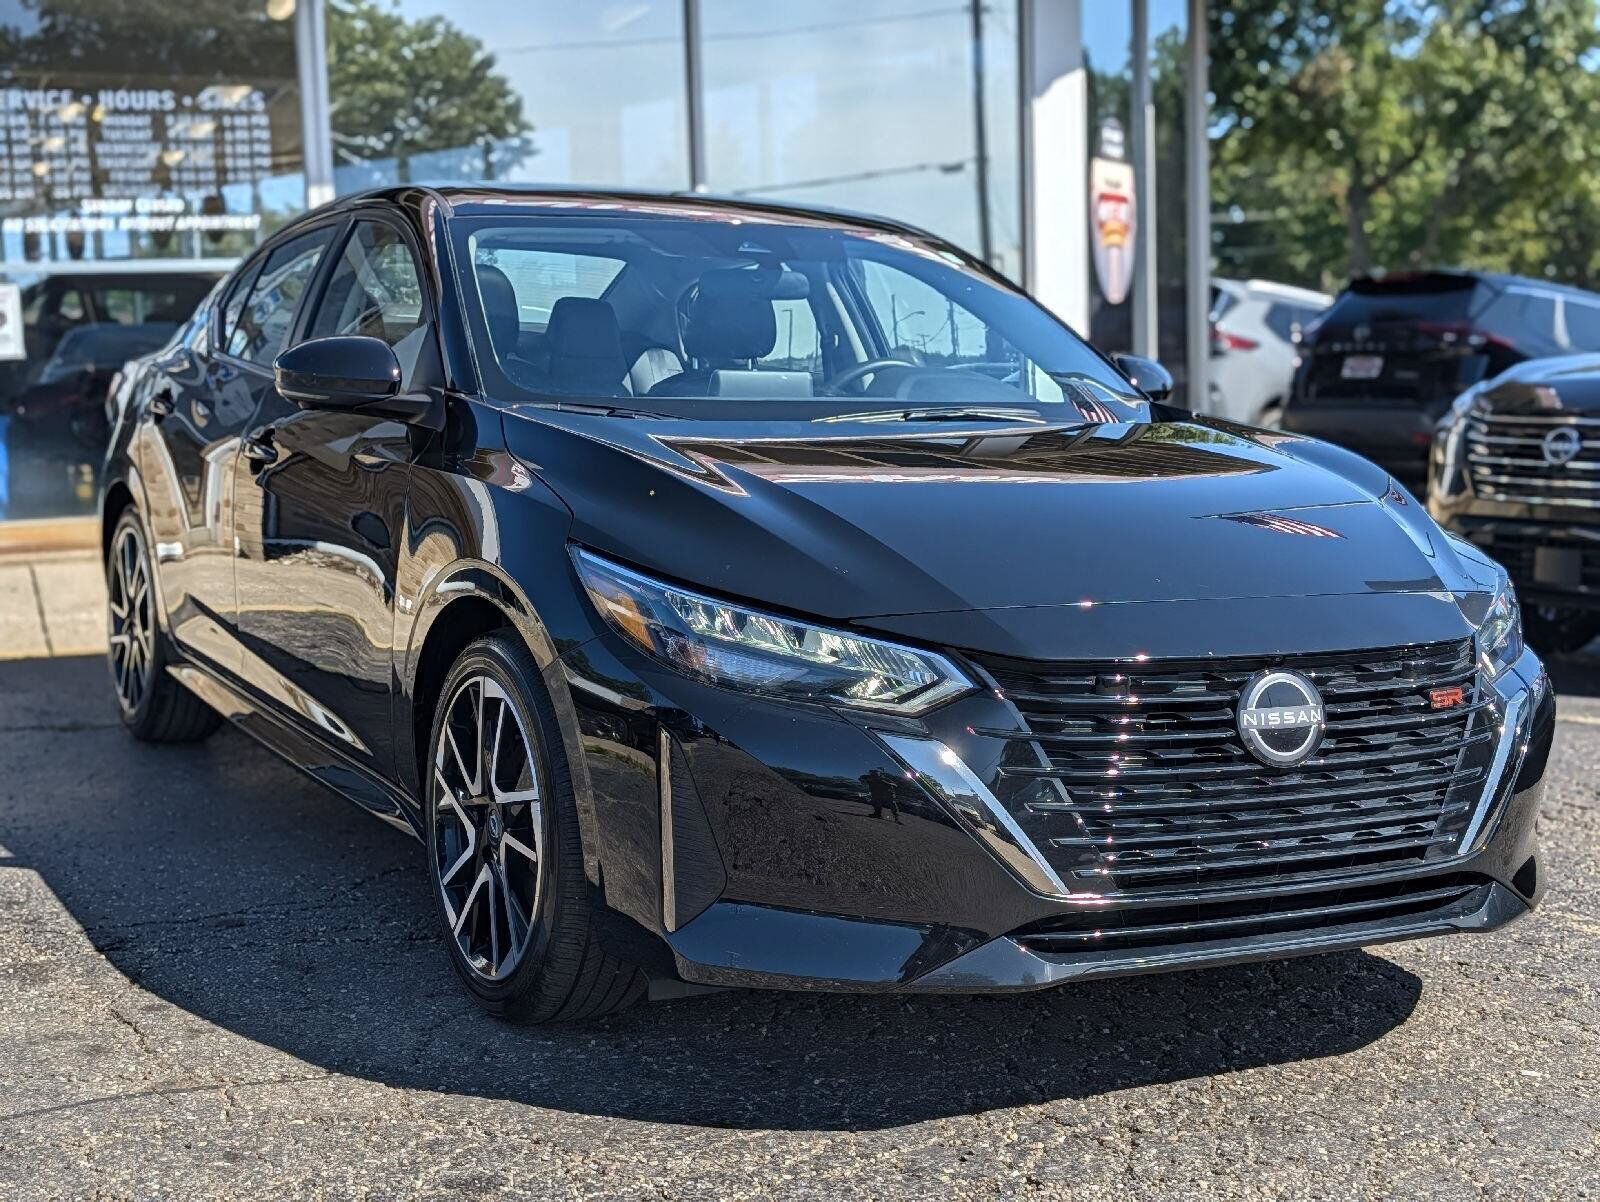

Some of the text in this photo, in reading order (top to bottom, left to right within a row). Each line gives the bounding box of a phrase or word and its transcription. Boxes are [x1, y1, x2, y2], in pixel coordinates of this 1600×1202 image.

[98, 90, 177, 111] HOURS
[1429, 686, 1463, 709] SR
[1242, 708, 1323, 727] NISSAN
